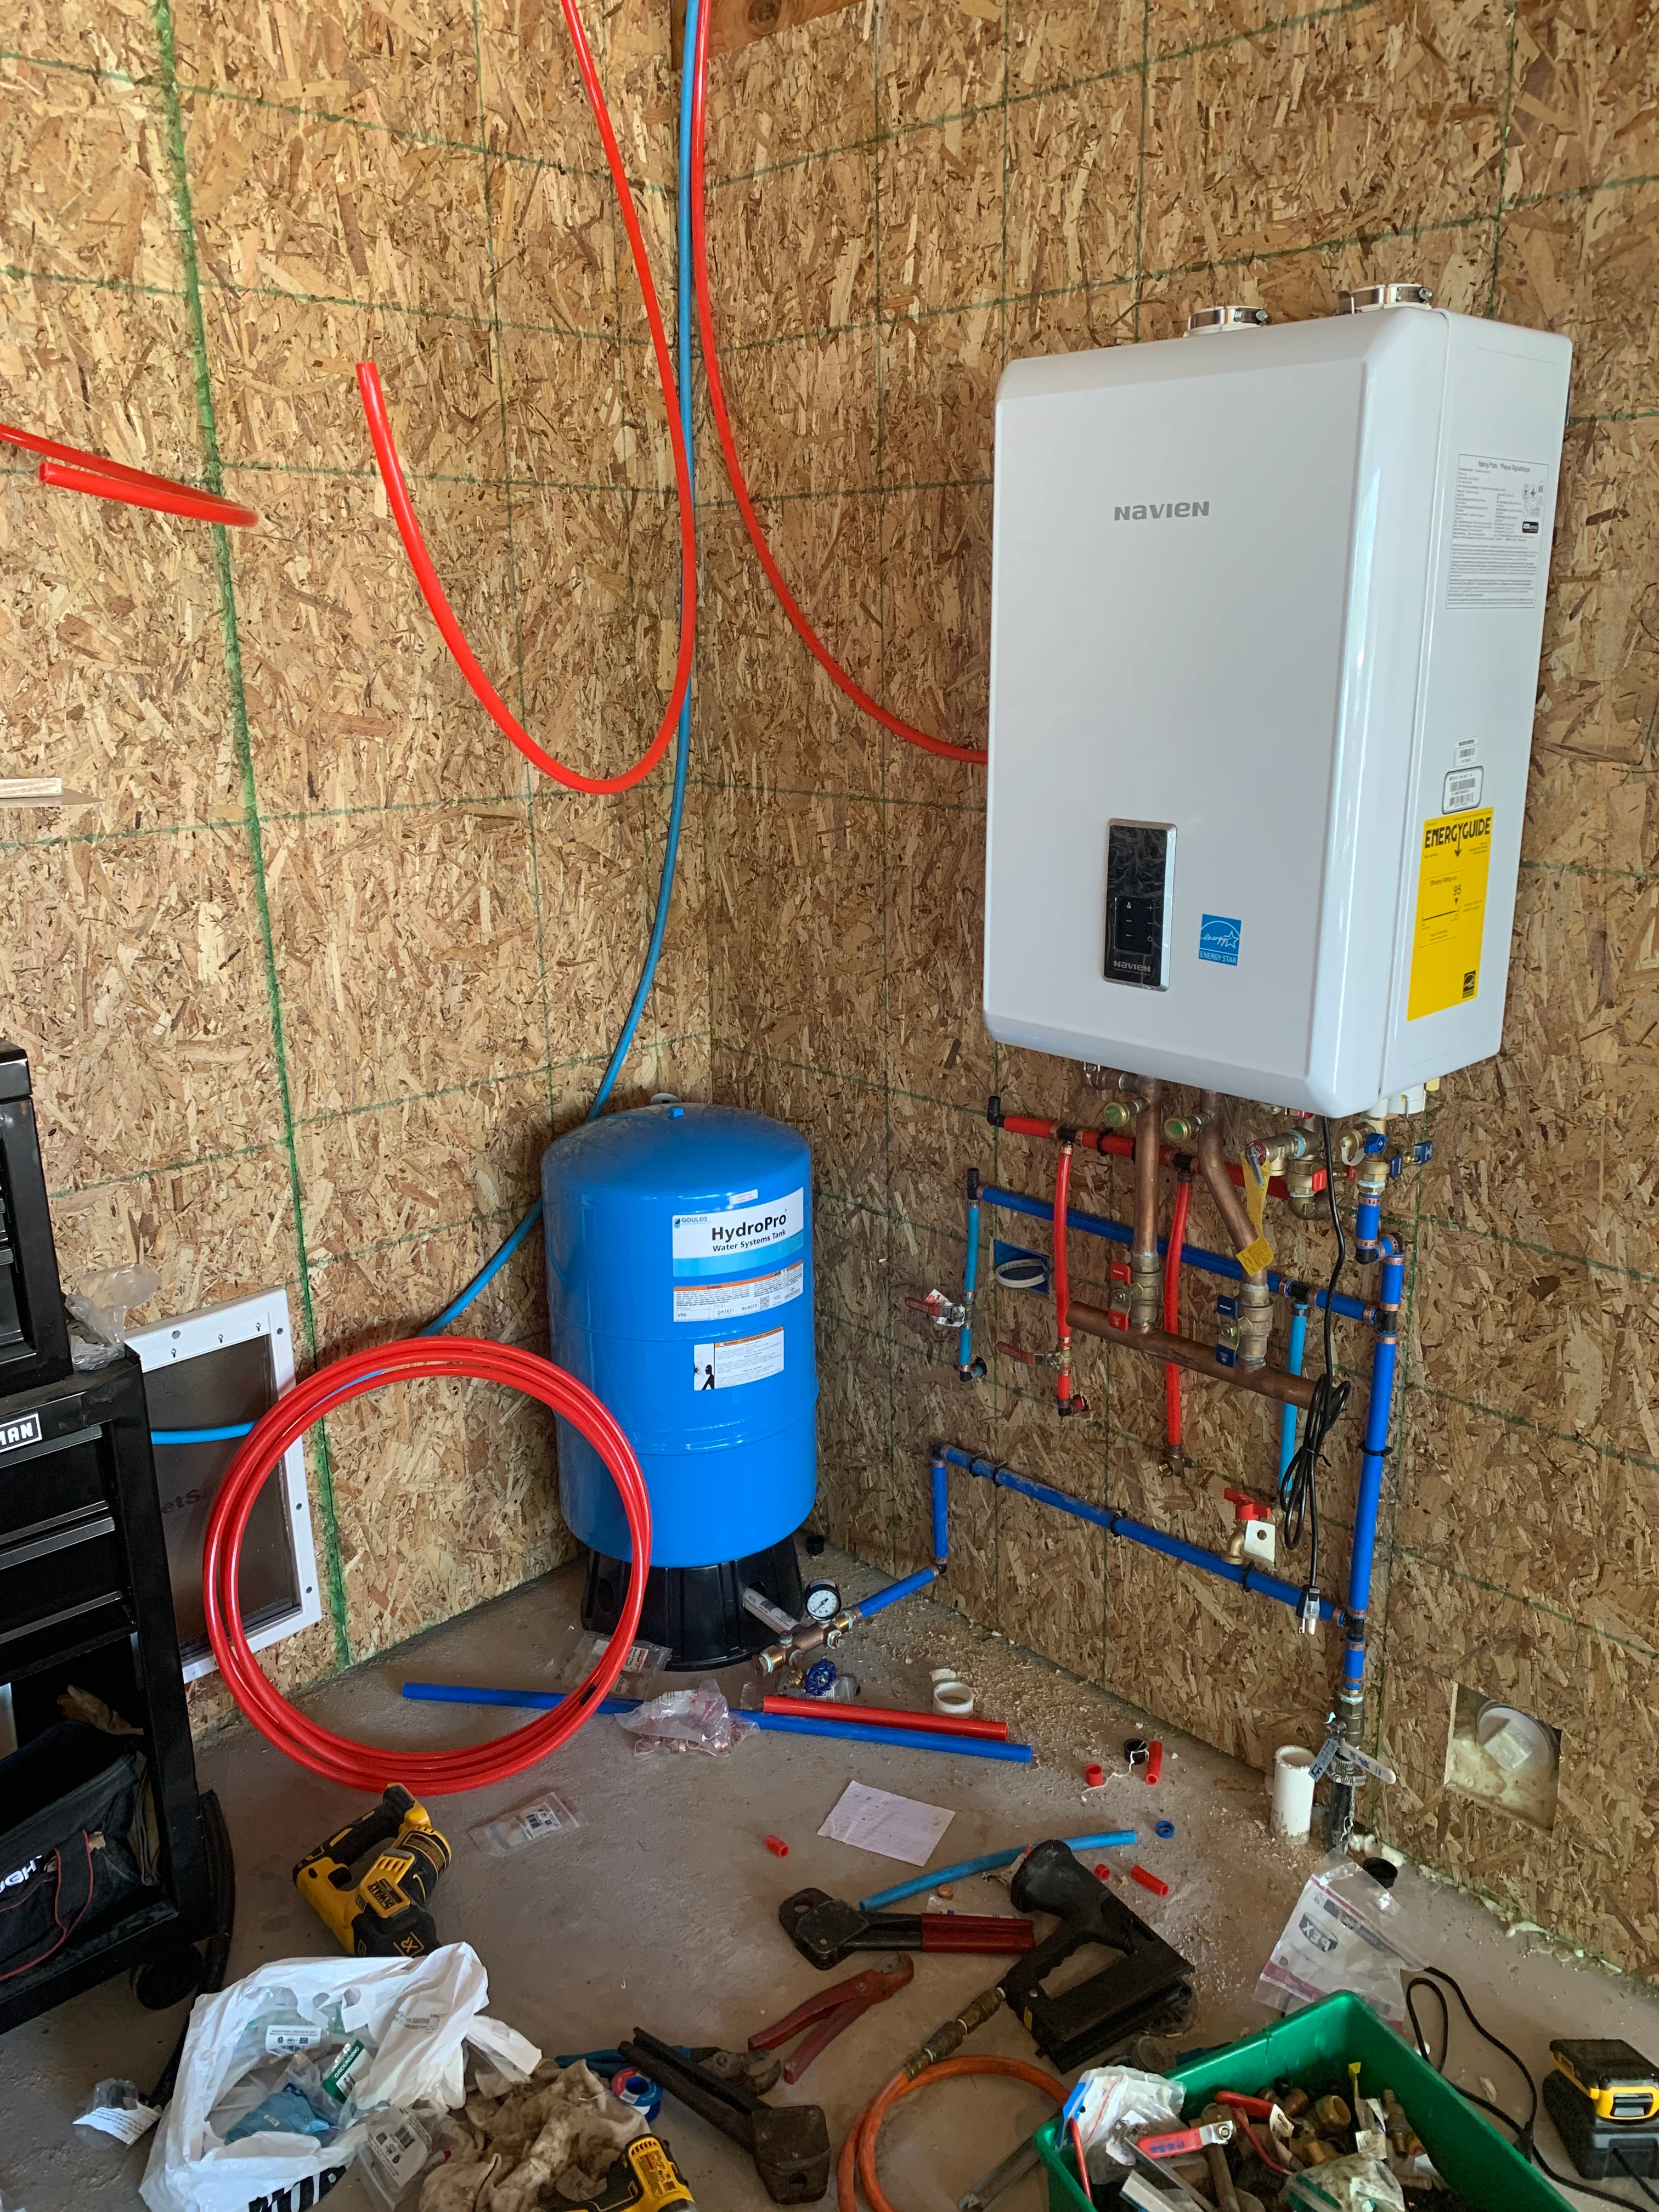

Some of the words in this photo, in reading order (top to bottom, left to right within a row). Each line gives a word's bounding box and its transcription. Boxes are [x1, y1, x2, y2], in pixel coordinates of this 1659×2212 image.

[1425, 817, 1492, 849] ENERGYGUIDE
[1453, 884, 1462, 896] 95
[1200, 951, 1222, 961] ENERGY
[1222, 955, 1237, 964] STAR
[712, 1214, 787, 1243] HydroPro
[713, 1243, 738, 1252] Water
[740, 1235, 771, 1248] Systems
[772, 1228, 786, 1239] Tank
[1311, 1763, 1323, 1778] LF
[334, 2046, 360, 2079] GROUNDING
